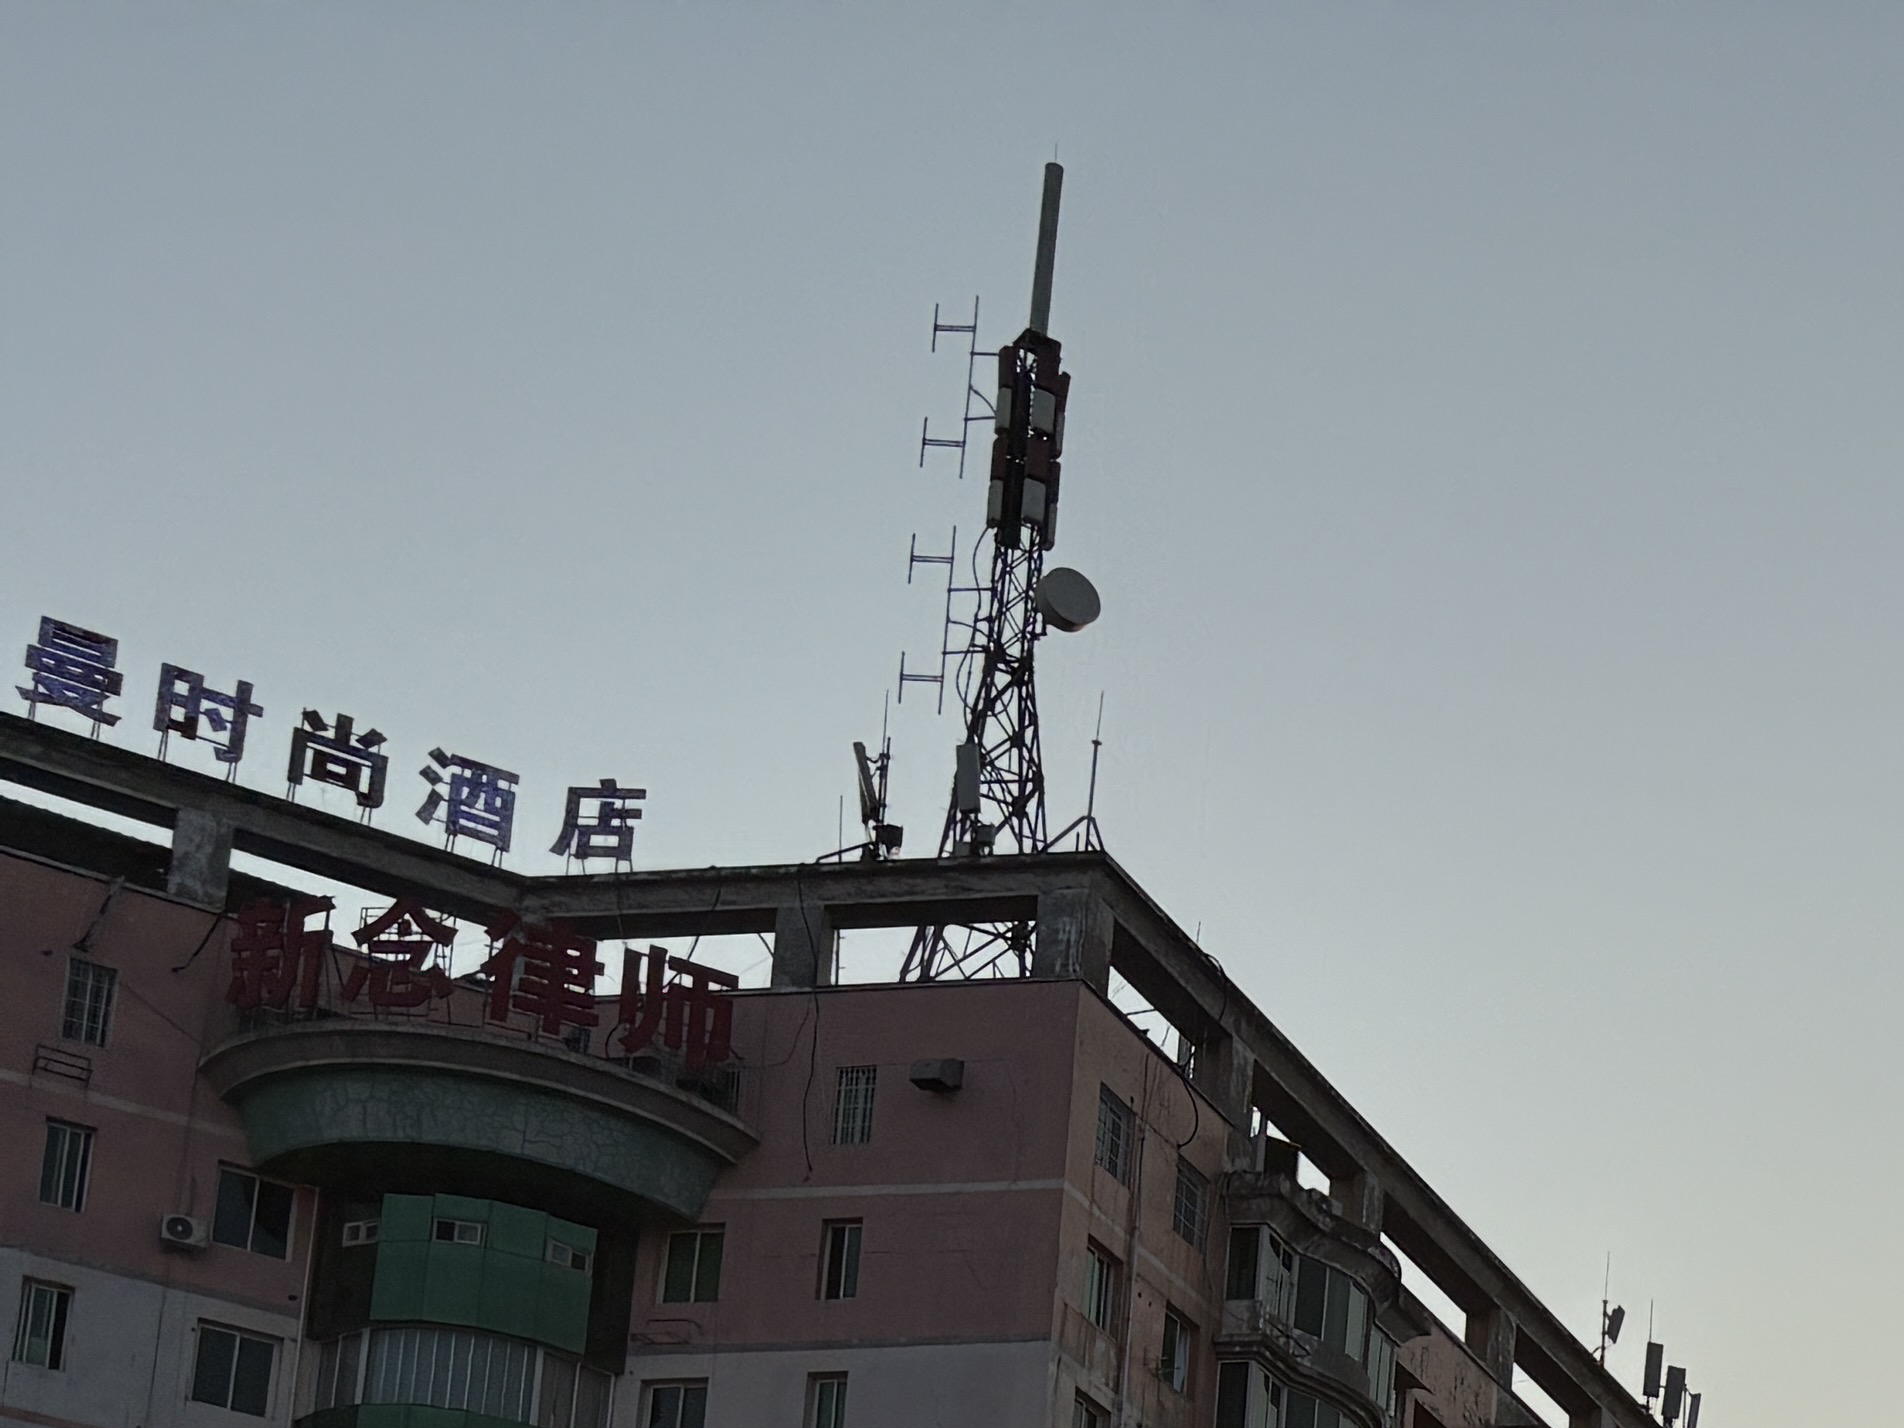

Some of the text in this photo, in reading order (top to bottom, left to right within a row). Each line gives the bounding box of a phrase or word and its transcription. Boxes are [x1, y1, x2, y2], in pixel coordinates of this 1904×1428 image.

[16, 615, 647, 862] 曼时尚酒店
